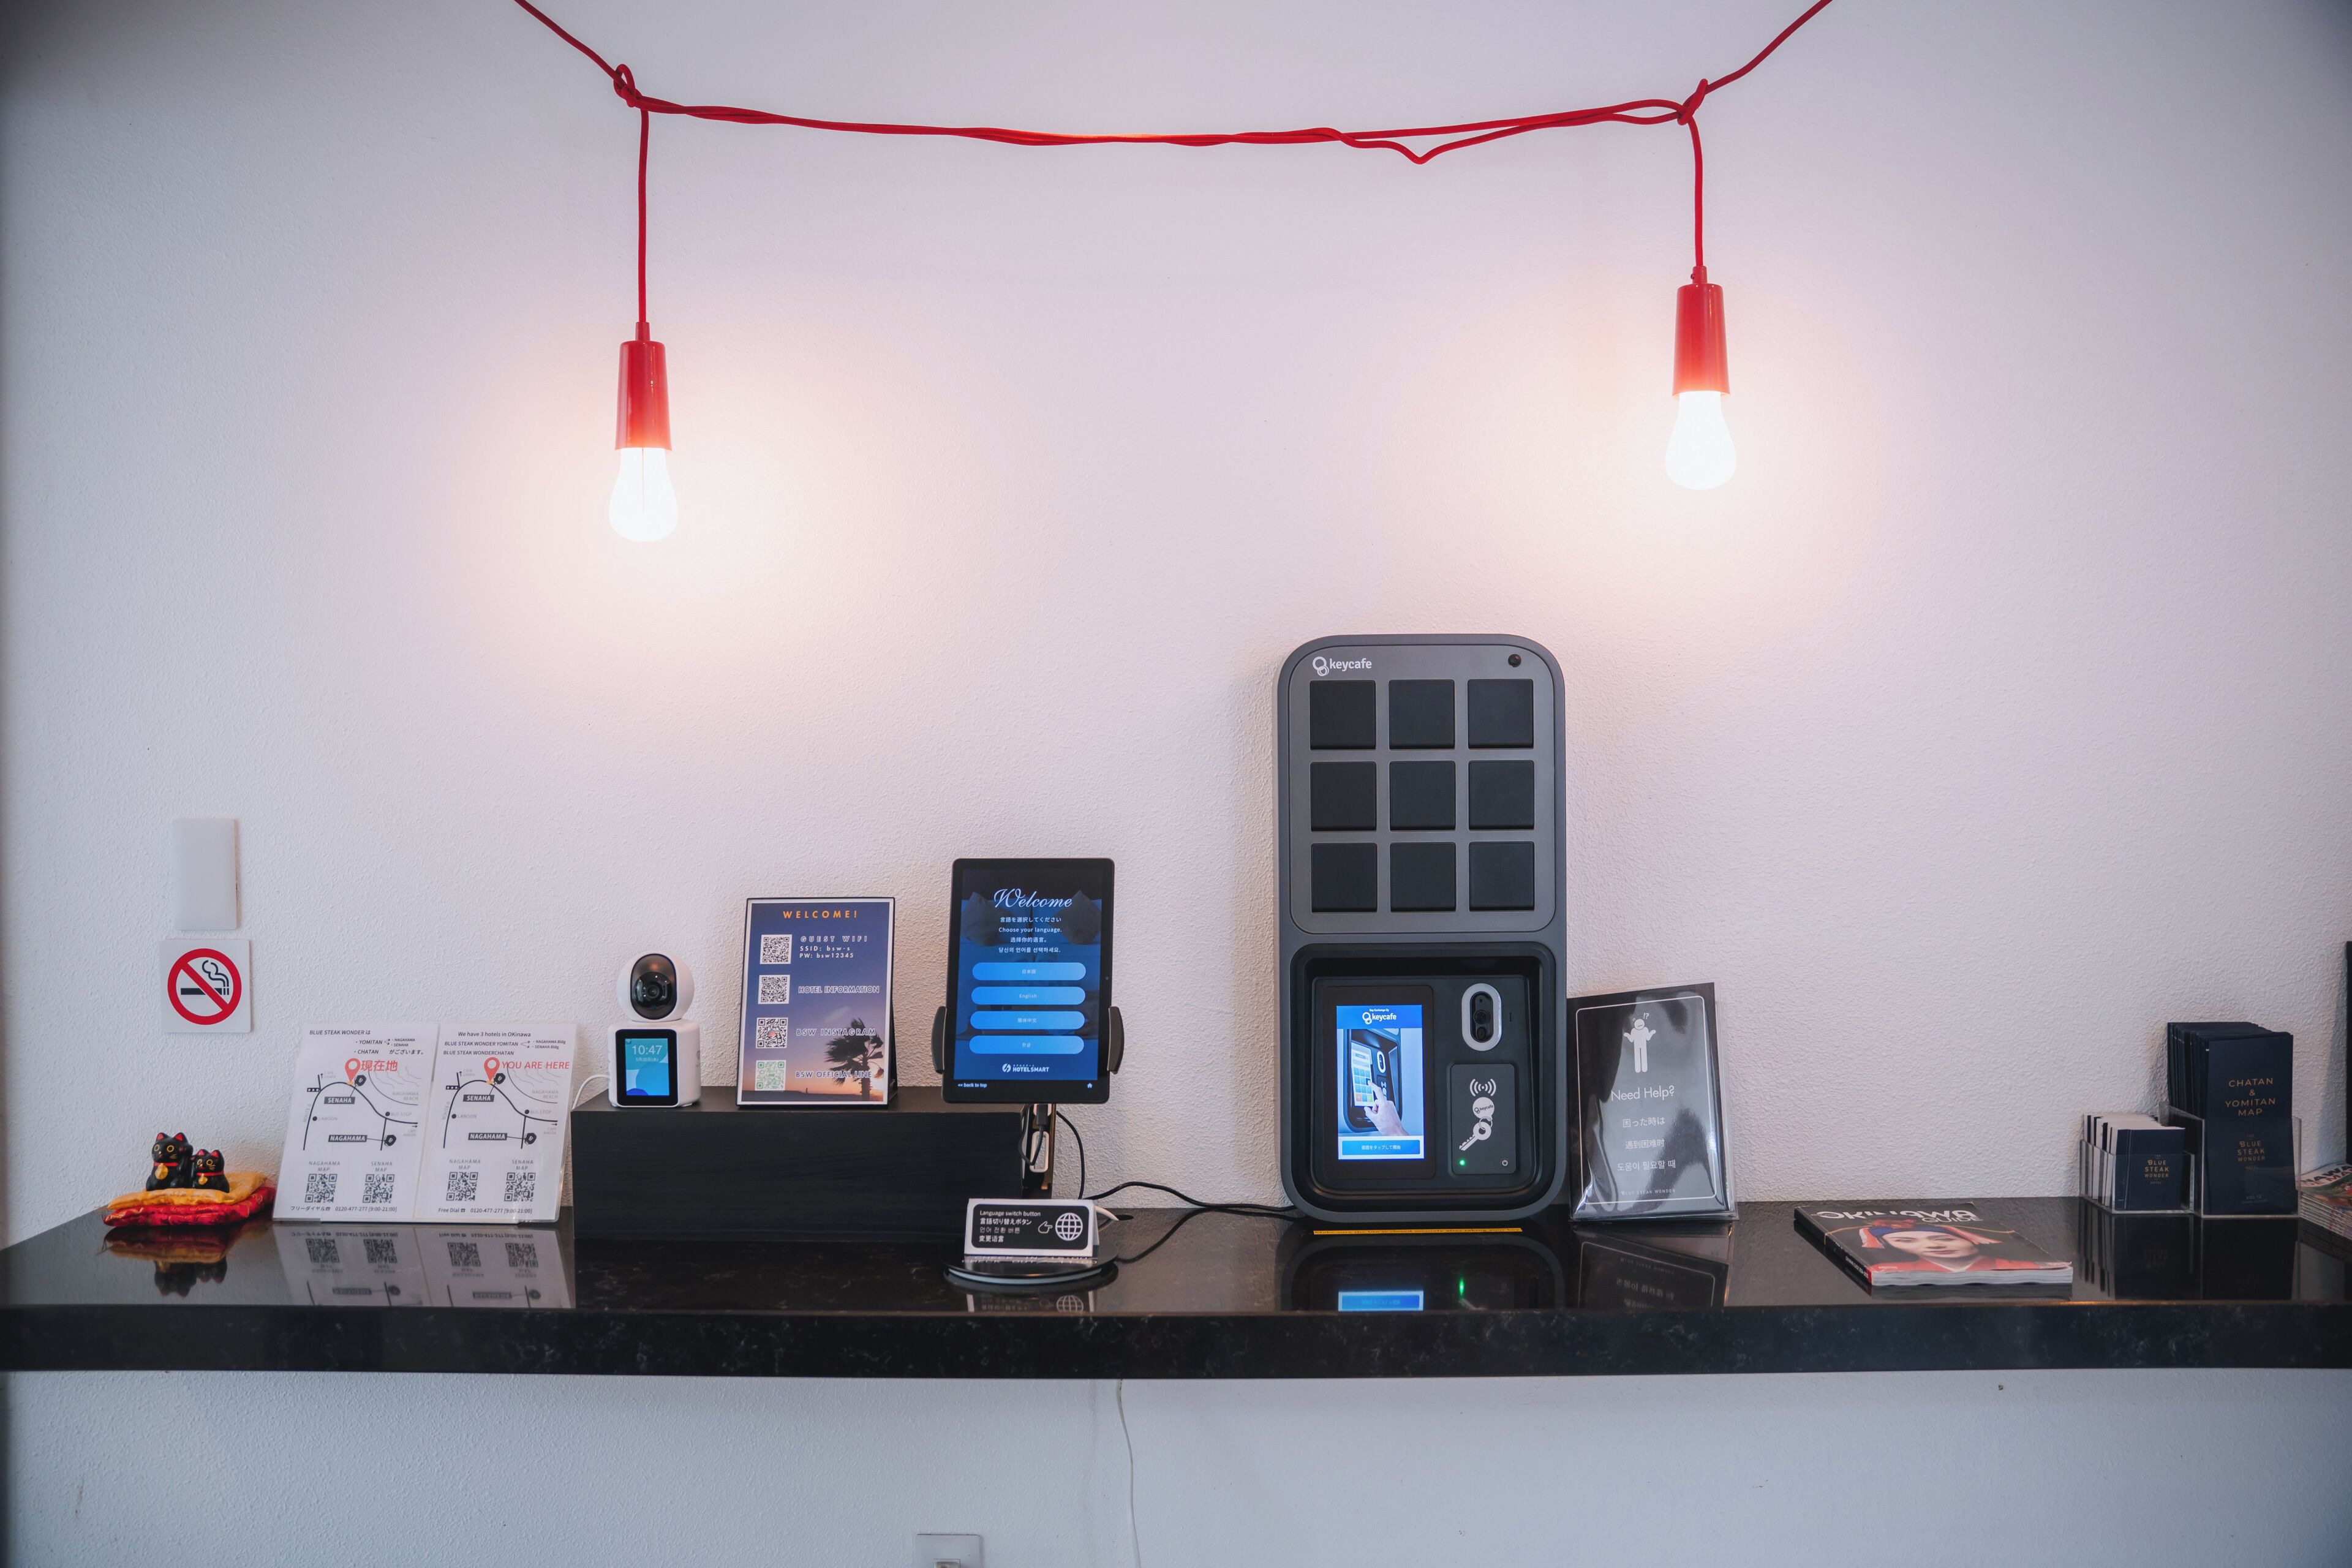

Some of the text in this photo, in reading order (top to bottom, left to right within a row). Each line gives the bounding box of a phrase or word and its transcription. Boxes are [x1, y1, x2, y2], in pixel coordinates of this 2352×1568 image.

[1329, 658, 1372, 672] keycafe
[993, 888, 1072, 908] Welcome
[783, 910, 858, 919] WELCOME!
[1372, 1012, 1397, 1022] keycafe
[632, 1044, 663, 1055] 10:47
[360, 1060, 398, 1072] 現在地
[2228, 1077, 2274, 1087] CHATAN
[1611, 1085, 1675, 1101] Need Help?
[2225, 1097, 2276, 1108] YOMITAN
[2238, 1108, 2263, 1117] MAP
[1623, 1117, 1665, 1128] 困った時は
[1618, 1161, 1640, 1171] 도움이
[1668, 1159, 1676, 1169] 때
